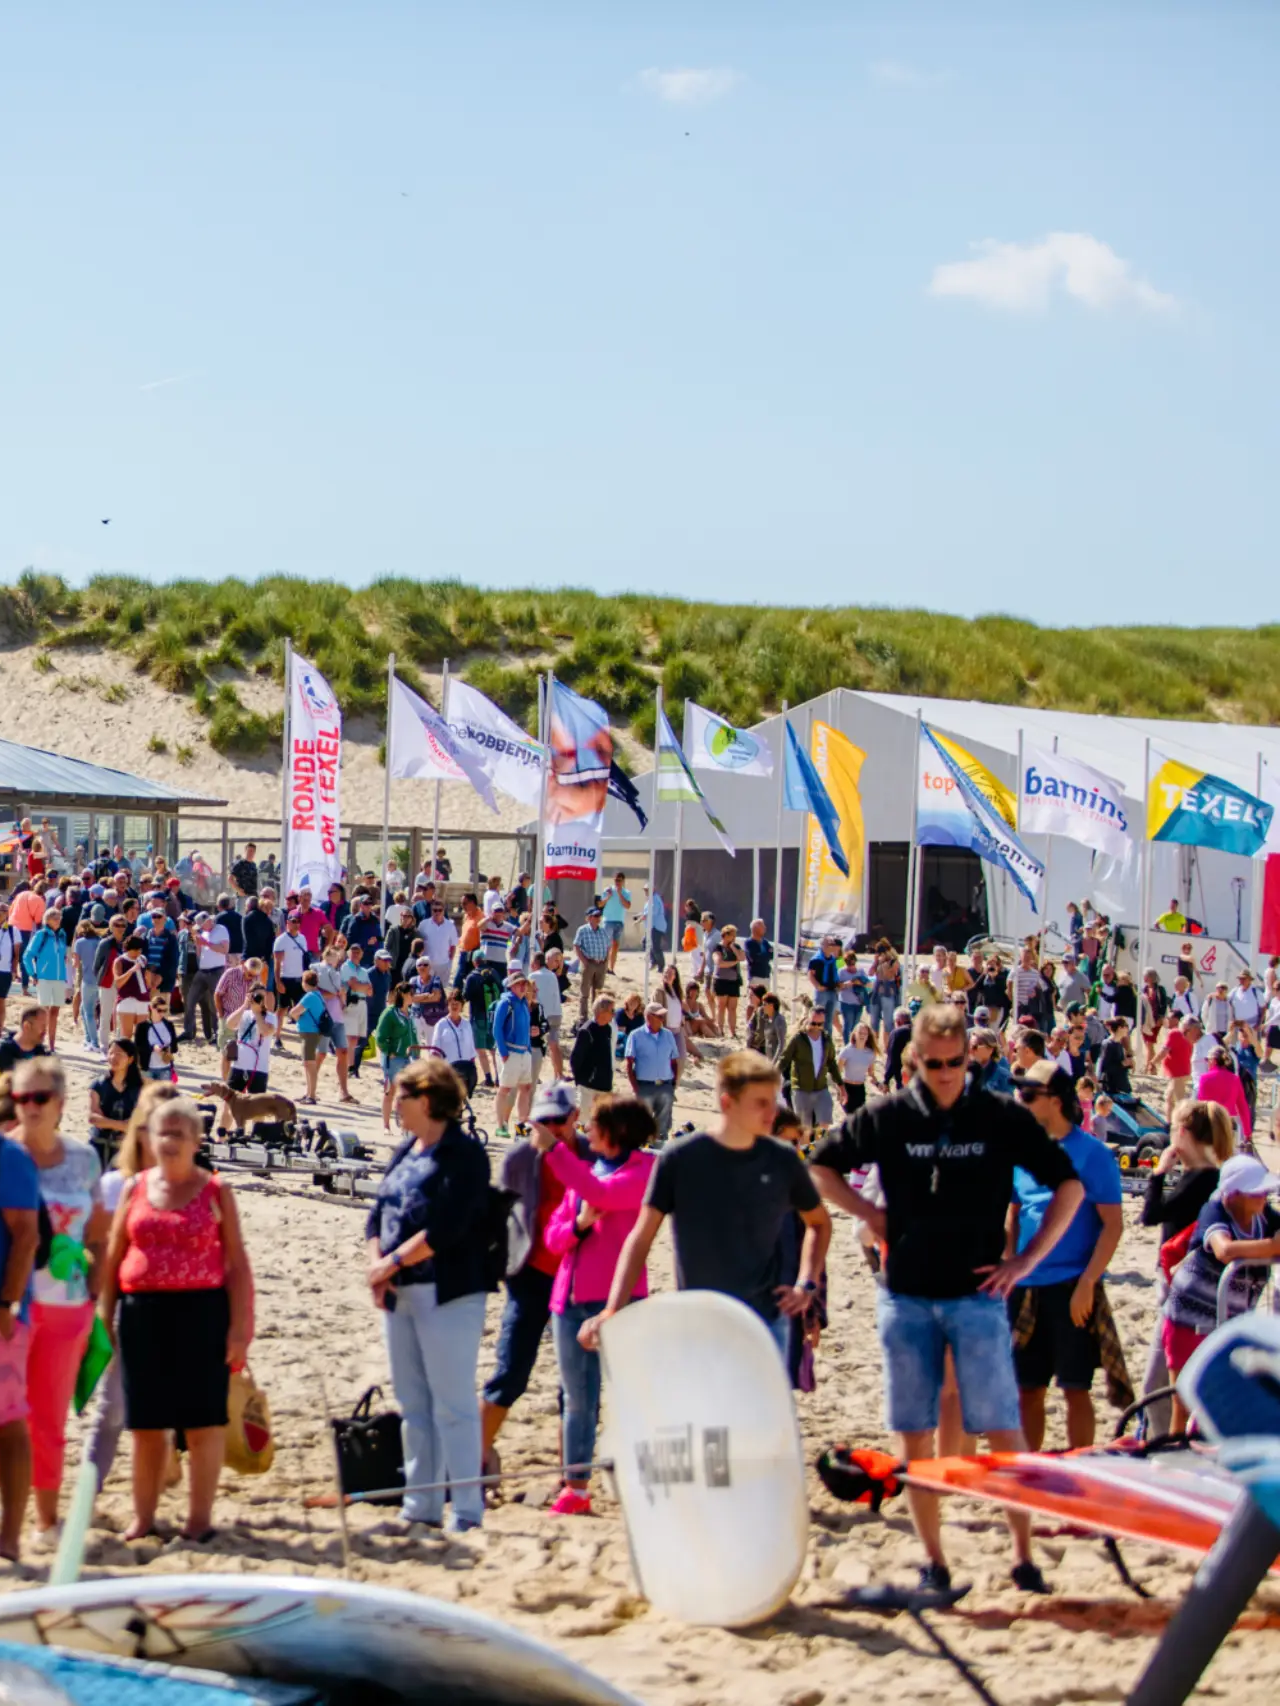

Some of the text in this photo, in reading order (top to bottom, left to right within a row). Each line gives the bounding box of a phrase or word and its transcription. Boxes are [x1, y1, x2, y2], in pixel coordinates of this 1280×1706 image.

[292, 739, 316, 832] RONDE
[1159, 783, 1260, 829] TEXEL
[320, 815, 336, 855] OM
